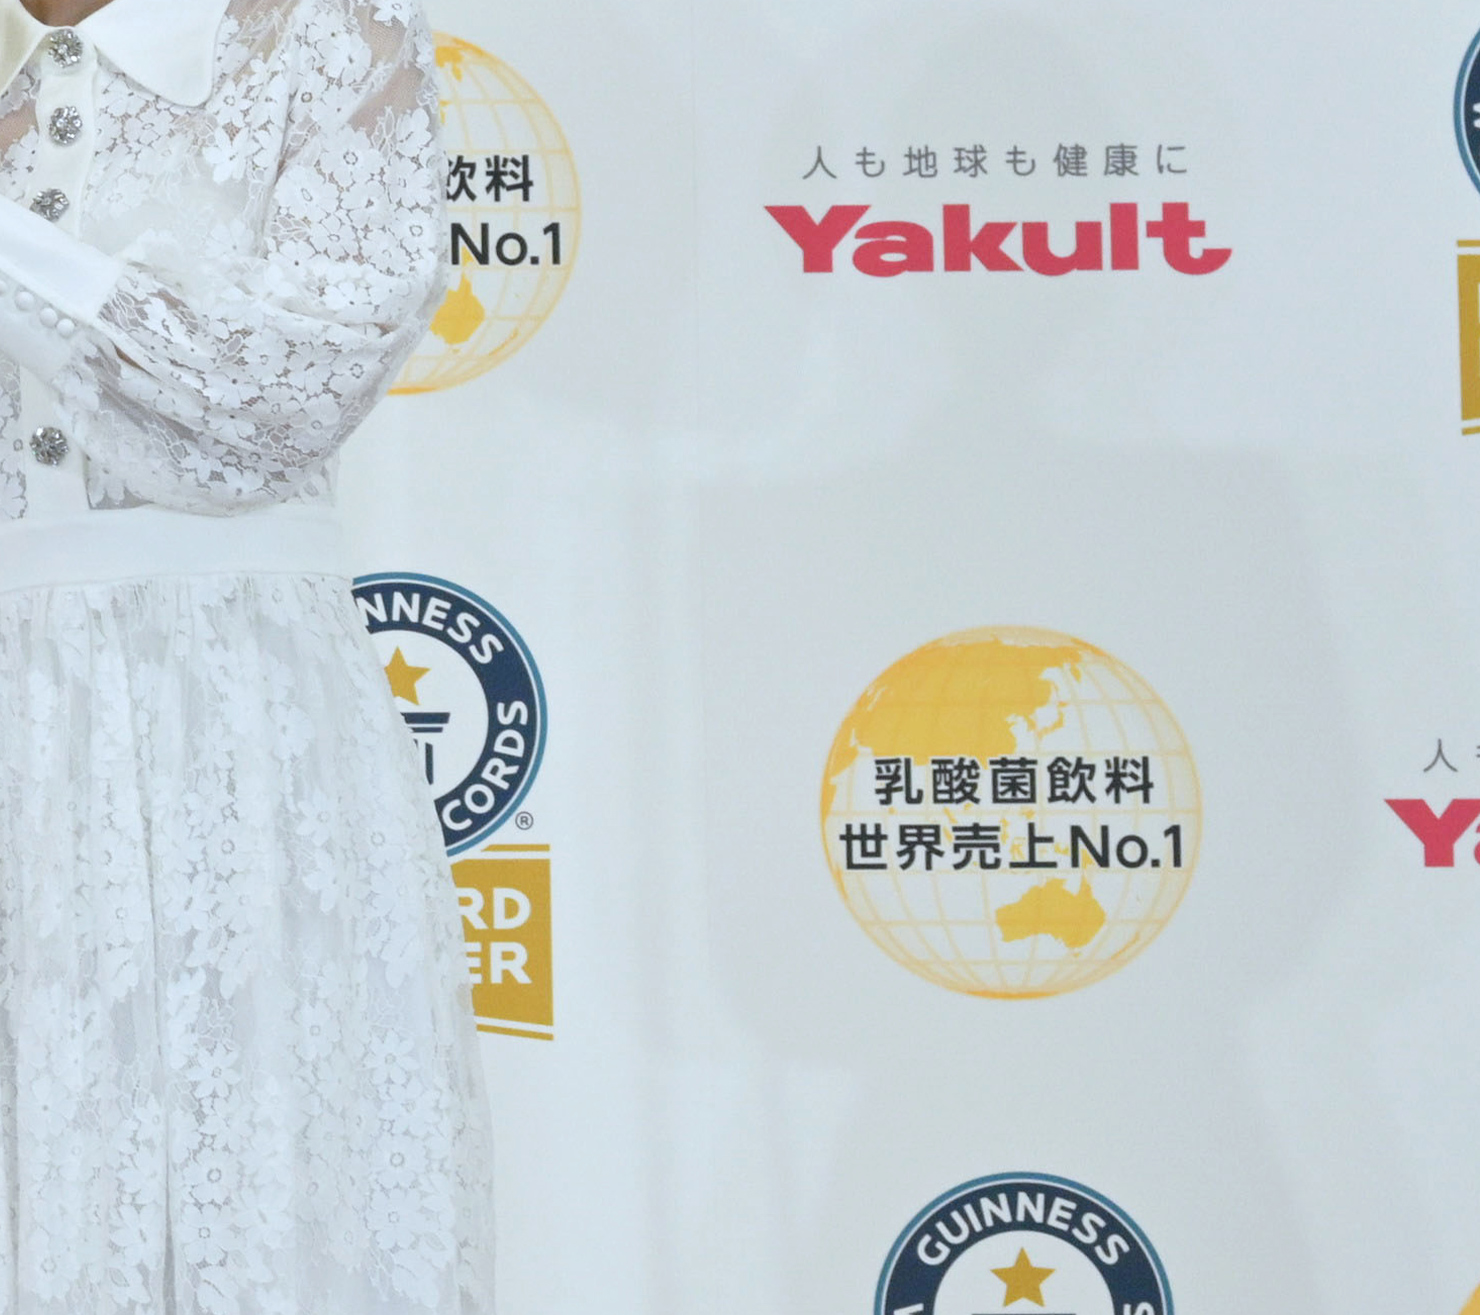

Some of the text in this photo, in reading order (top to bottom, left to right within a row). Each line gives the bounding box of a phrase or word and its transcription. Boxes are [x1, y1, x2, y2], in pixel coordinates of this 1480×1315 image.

[801, 143, 1190, 180] 人も地球も健康に
[763, 202, 1233, 278] Yakult
[873, 756, 1155, 806] 乳酸菌飲料
[839, 823, 1186, 872] 世界売上No.1
[917, 1191, 1130, 1268] GUINNESS
